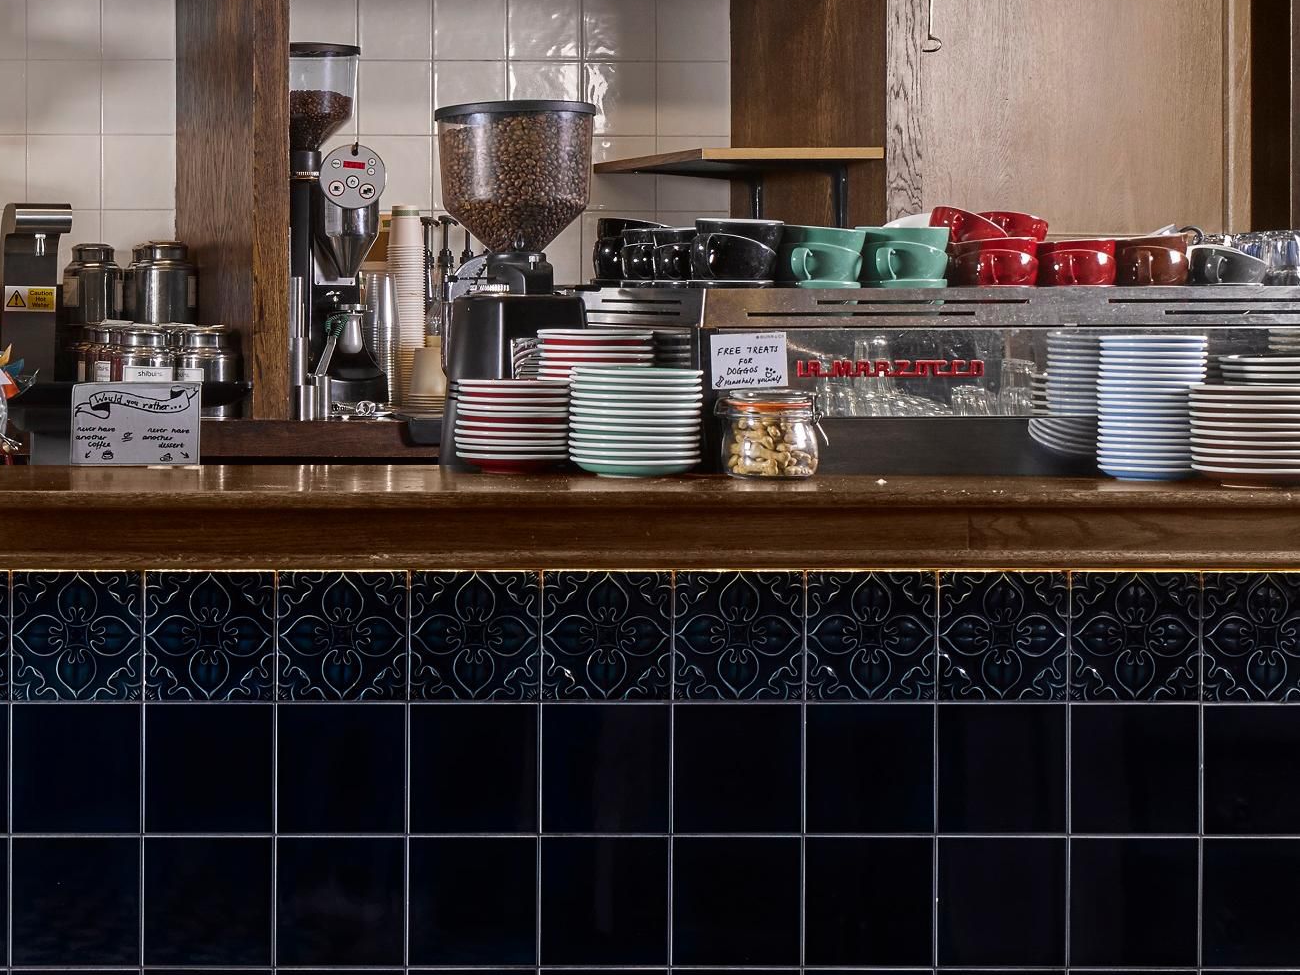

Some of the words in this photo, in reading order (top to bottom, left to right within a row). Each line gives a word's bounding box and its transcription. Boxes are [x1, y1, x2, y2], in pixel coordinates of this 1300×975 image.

[717, 347, 741, 355] FREE
[747, 346, 778, 354] TREATS
[727, 366, 758, 375] DOGGOS
[95, 394, 122, 405] Would
